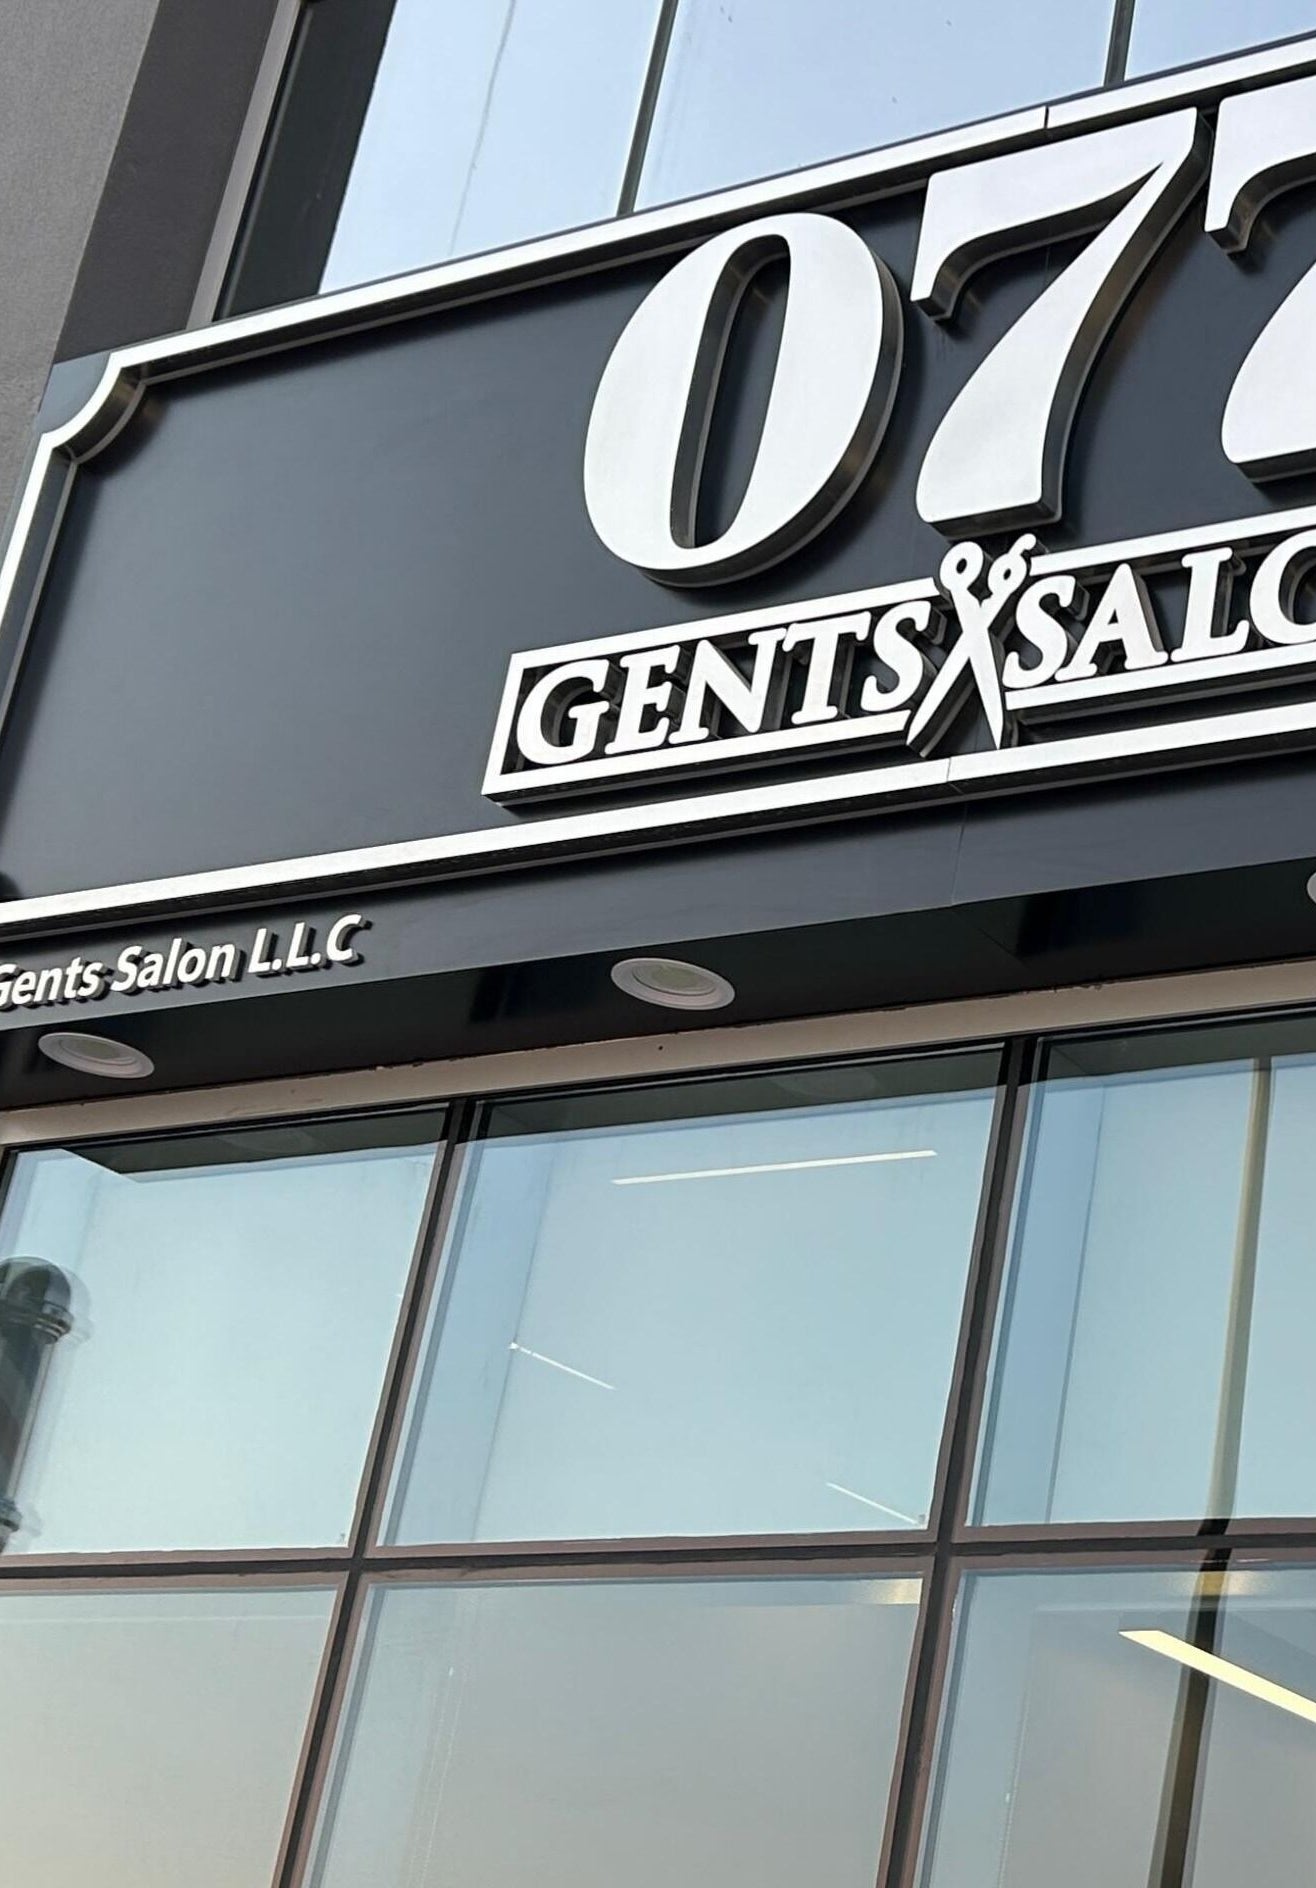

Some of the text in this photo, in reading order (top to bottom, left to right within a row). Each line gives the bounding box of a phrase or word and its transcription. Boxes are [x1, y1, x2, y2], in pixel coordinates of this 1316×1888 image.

[514, 597, 932, 766] GENTS
[109, 938, 238, 993] Salon
[248, 913, 363, 974] L.L.C
